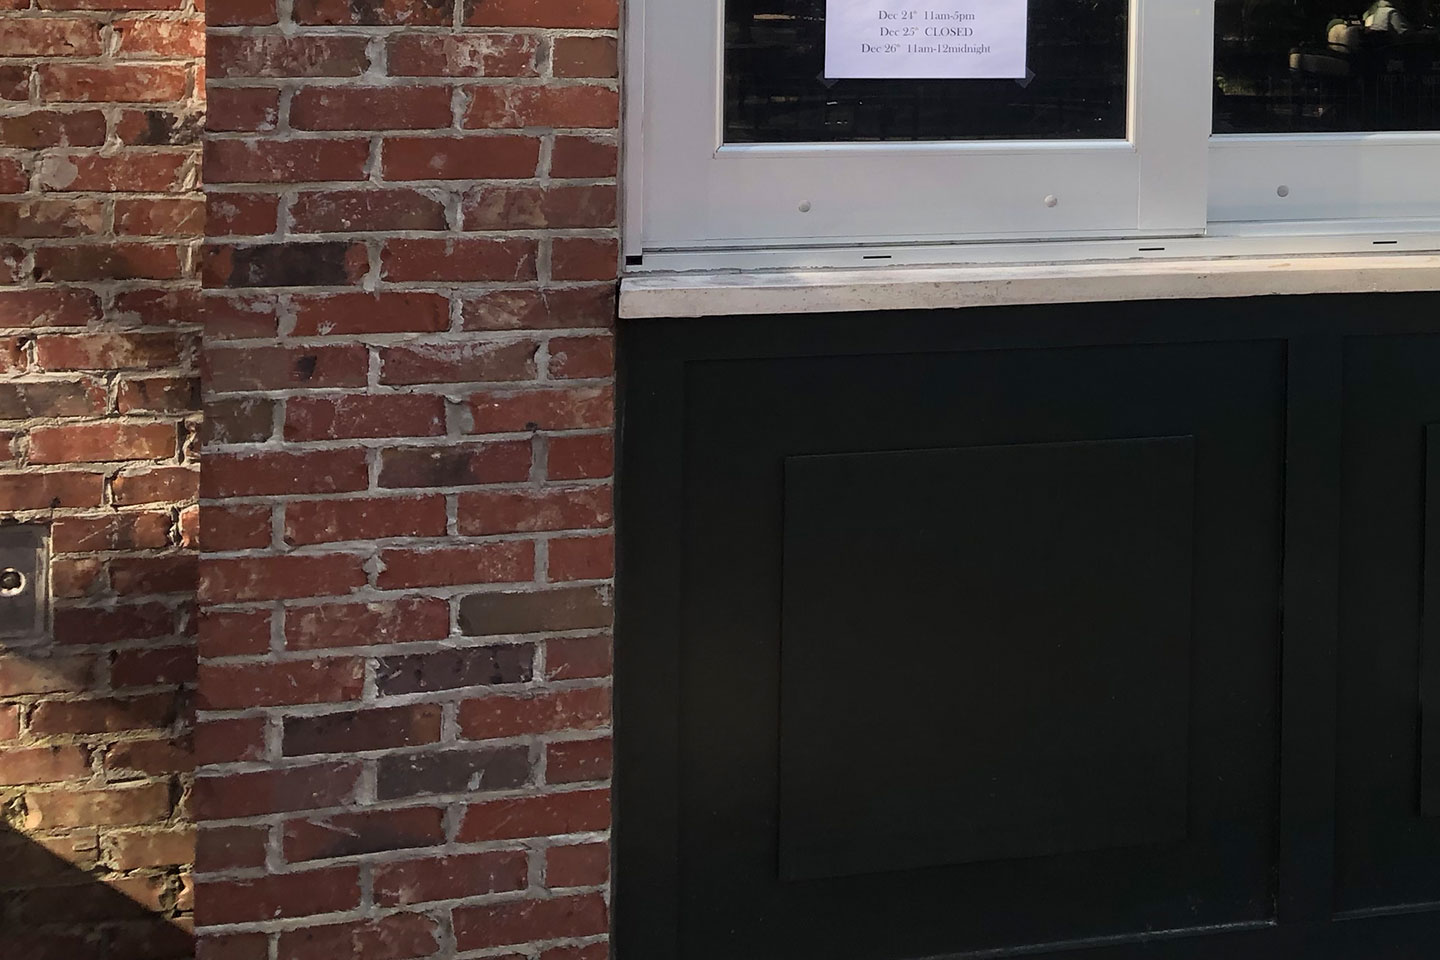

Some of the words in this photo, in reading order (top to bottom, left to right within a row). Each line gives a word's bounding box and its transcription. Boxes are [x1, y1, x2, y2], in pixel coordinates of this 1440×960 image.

[878, 10, 898, 20] Dec
[880, 27, 899, 36] Dec
[925, 27, 973, 37] CLOSED
[861, 44, 881, 53] Dec
